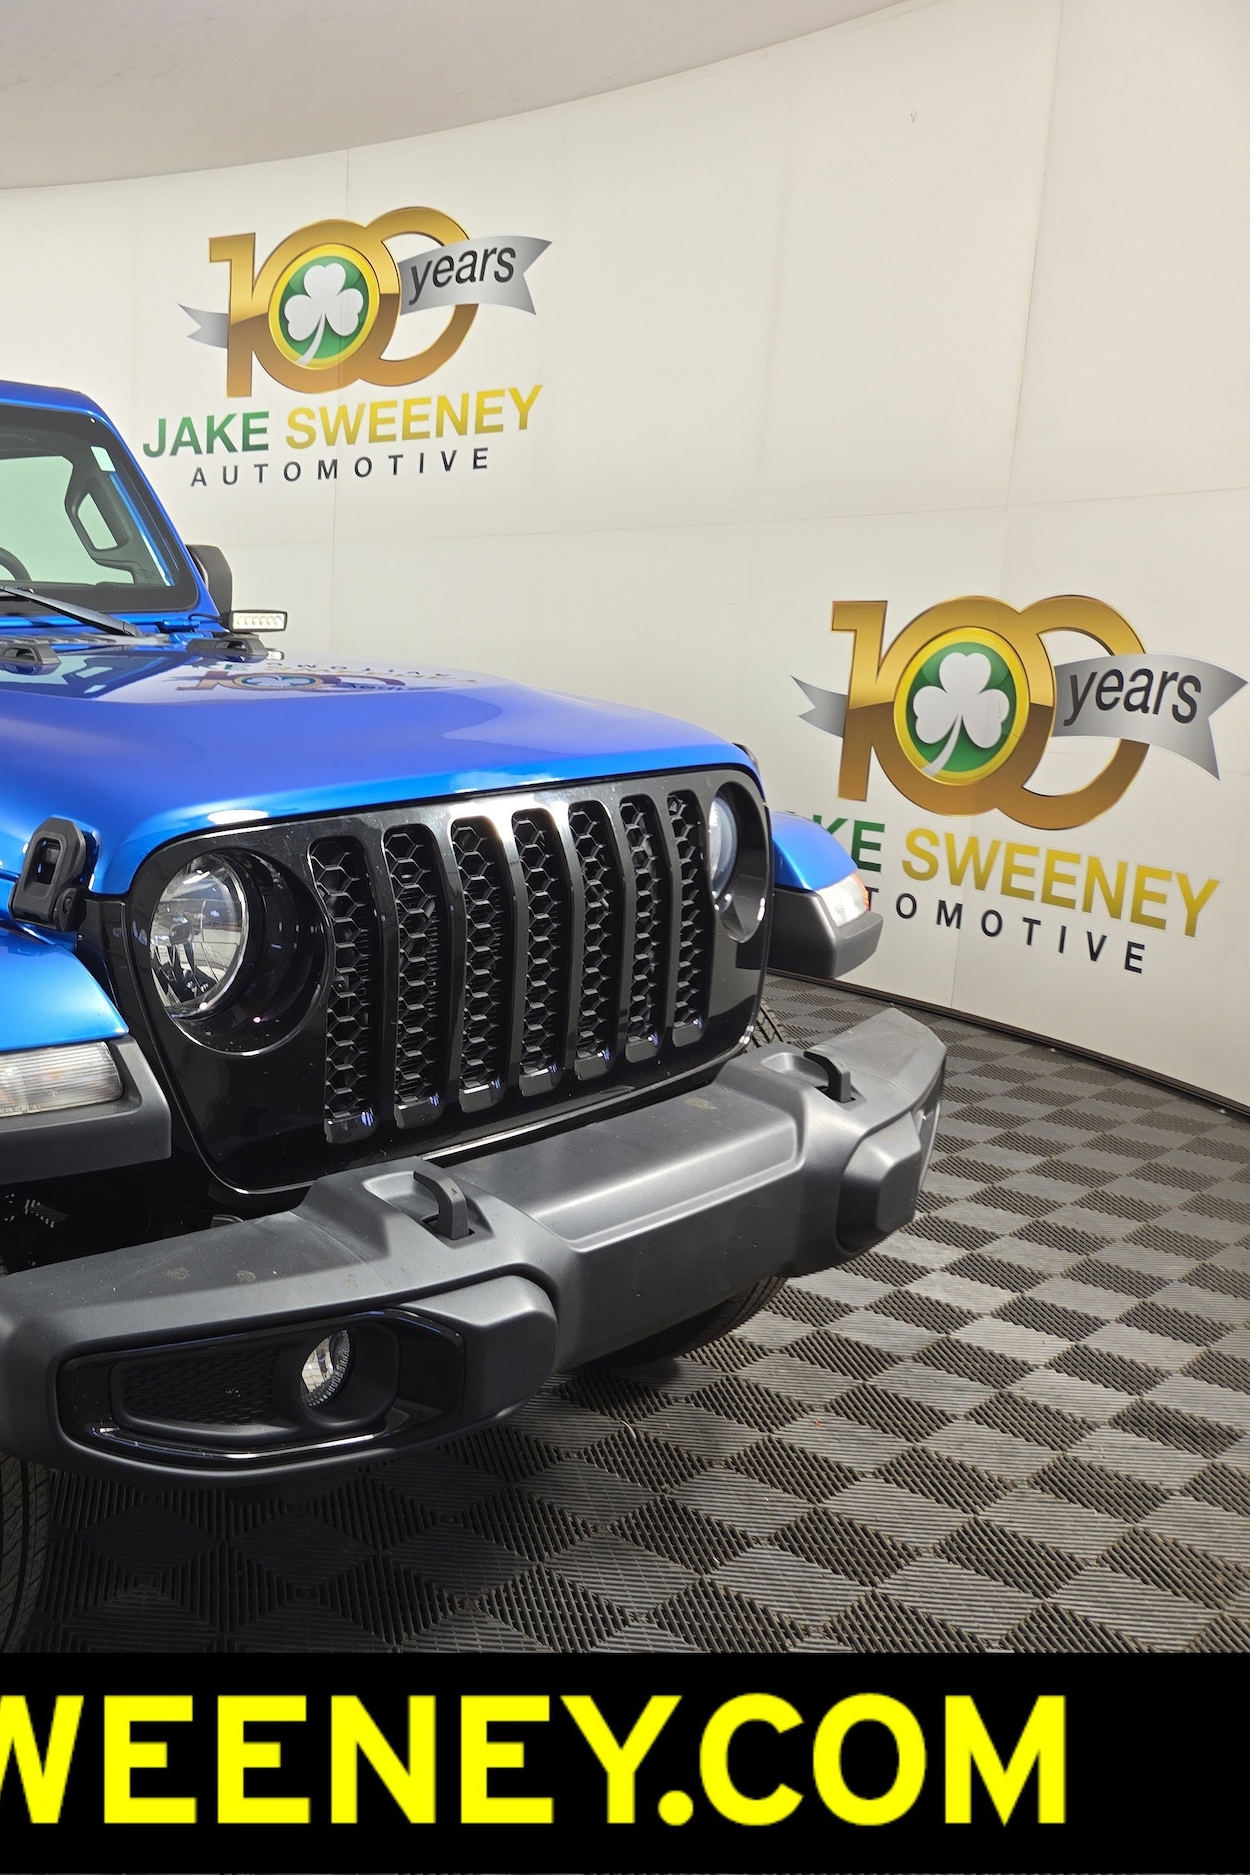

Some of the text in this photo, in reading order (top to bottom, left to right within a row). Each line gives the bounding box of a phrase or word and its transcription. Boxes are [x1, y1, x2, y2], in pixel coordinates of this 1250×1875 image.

[208, 206, 517, 398] 100 years
[142, 384, 544, 459] JAKE SWEENEY
[190, 446, 490, 487] AUTOMOTIVE
[830, 593, 1203, 831] 100 years
[864, 885, 1146, 974] TOMOTIVE
[901, 827, 1221, 938] SWEENEY
